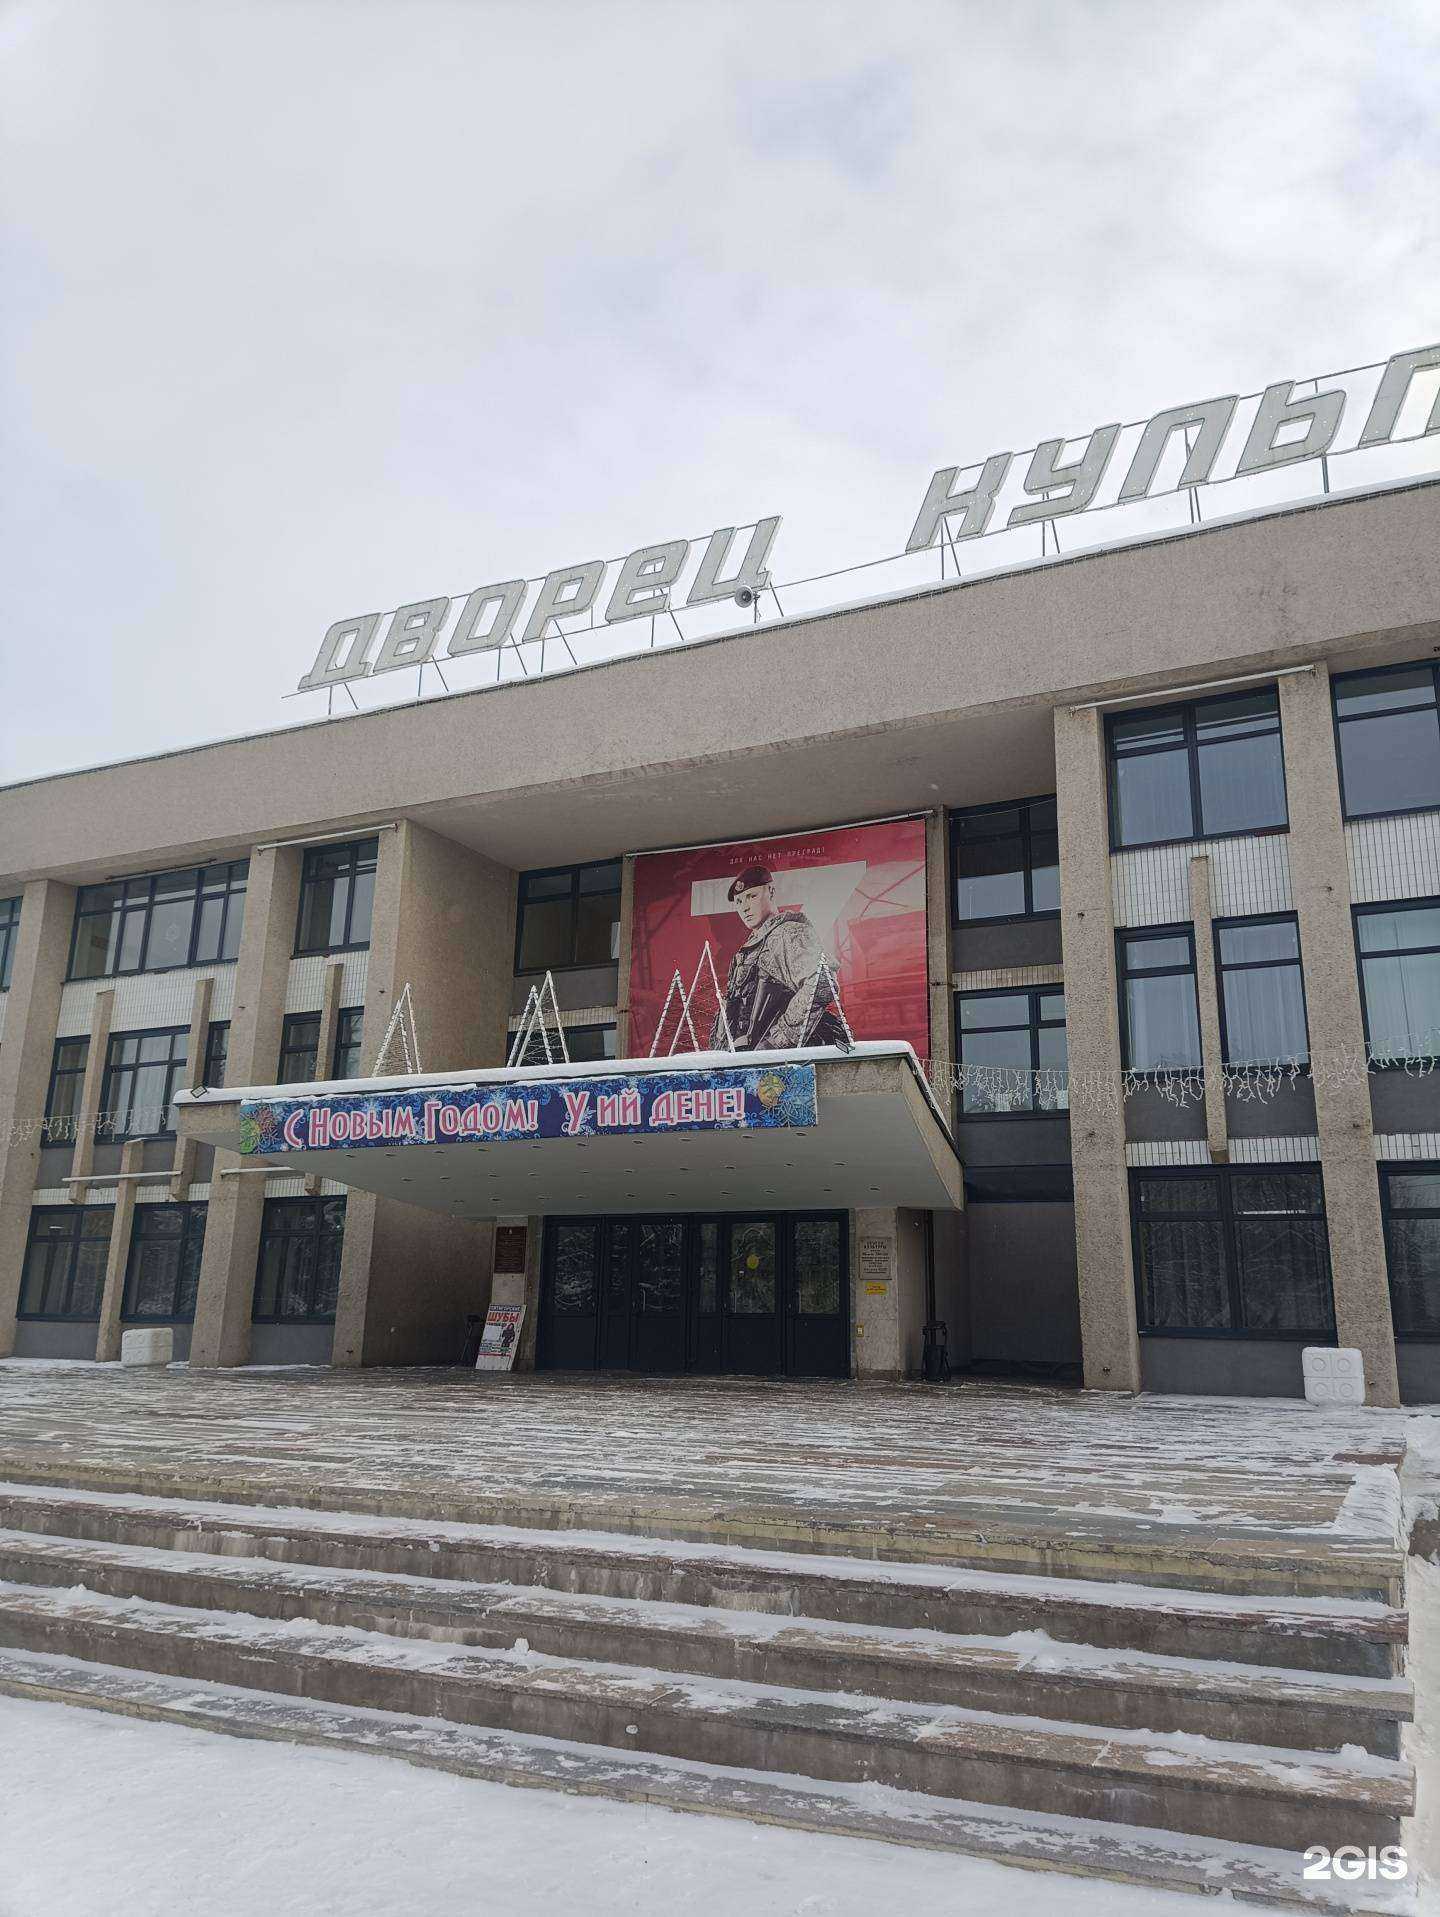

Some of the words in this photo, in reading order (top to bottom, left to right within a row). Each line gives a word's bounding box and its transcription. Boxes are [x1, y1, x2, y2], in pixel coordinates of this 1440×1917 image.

[748, 855, 762, 864] НАС
[767, 852, 781, 860] НЕТ
[284, 1108, 304, 1148] С
[309, 1105, 417, 1147] НОВЫМ
[424, 1099, 539, 1141] ГОДОМ!
[564, 1090, 590, 1135] У
[597, 1087, 641, 1127] ИЙ
[648, 1087, 746, 1127] ДЕНЕ!
[486, 1311, 520, 1323] ШУБЫ
